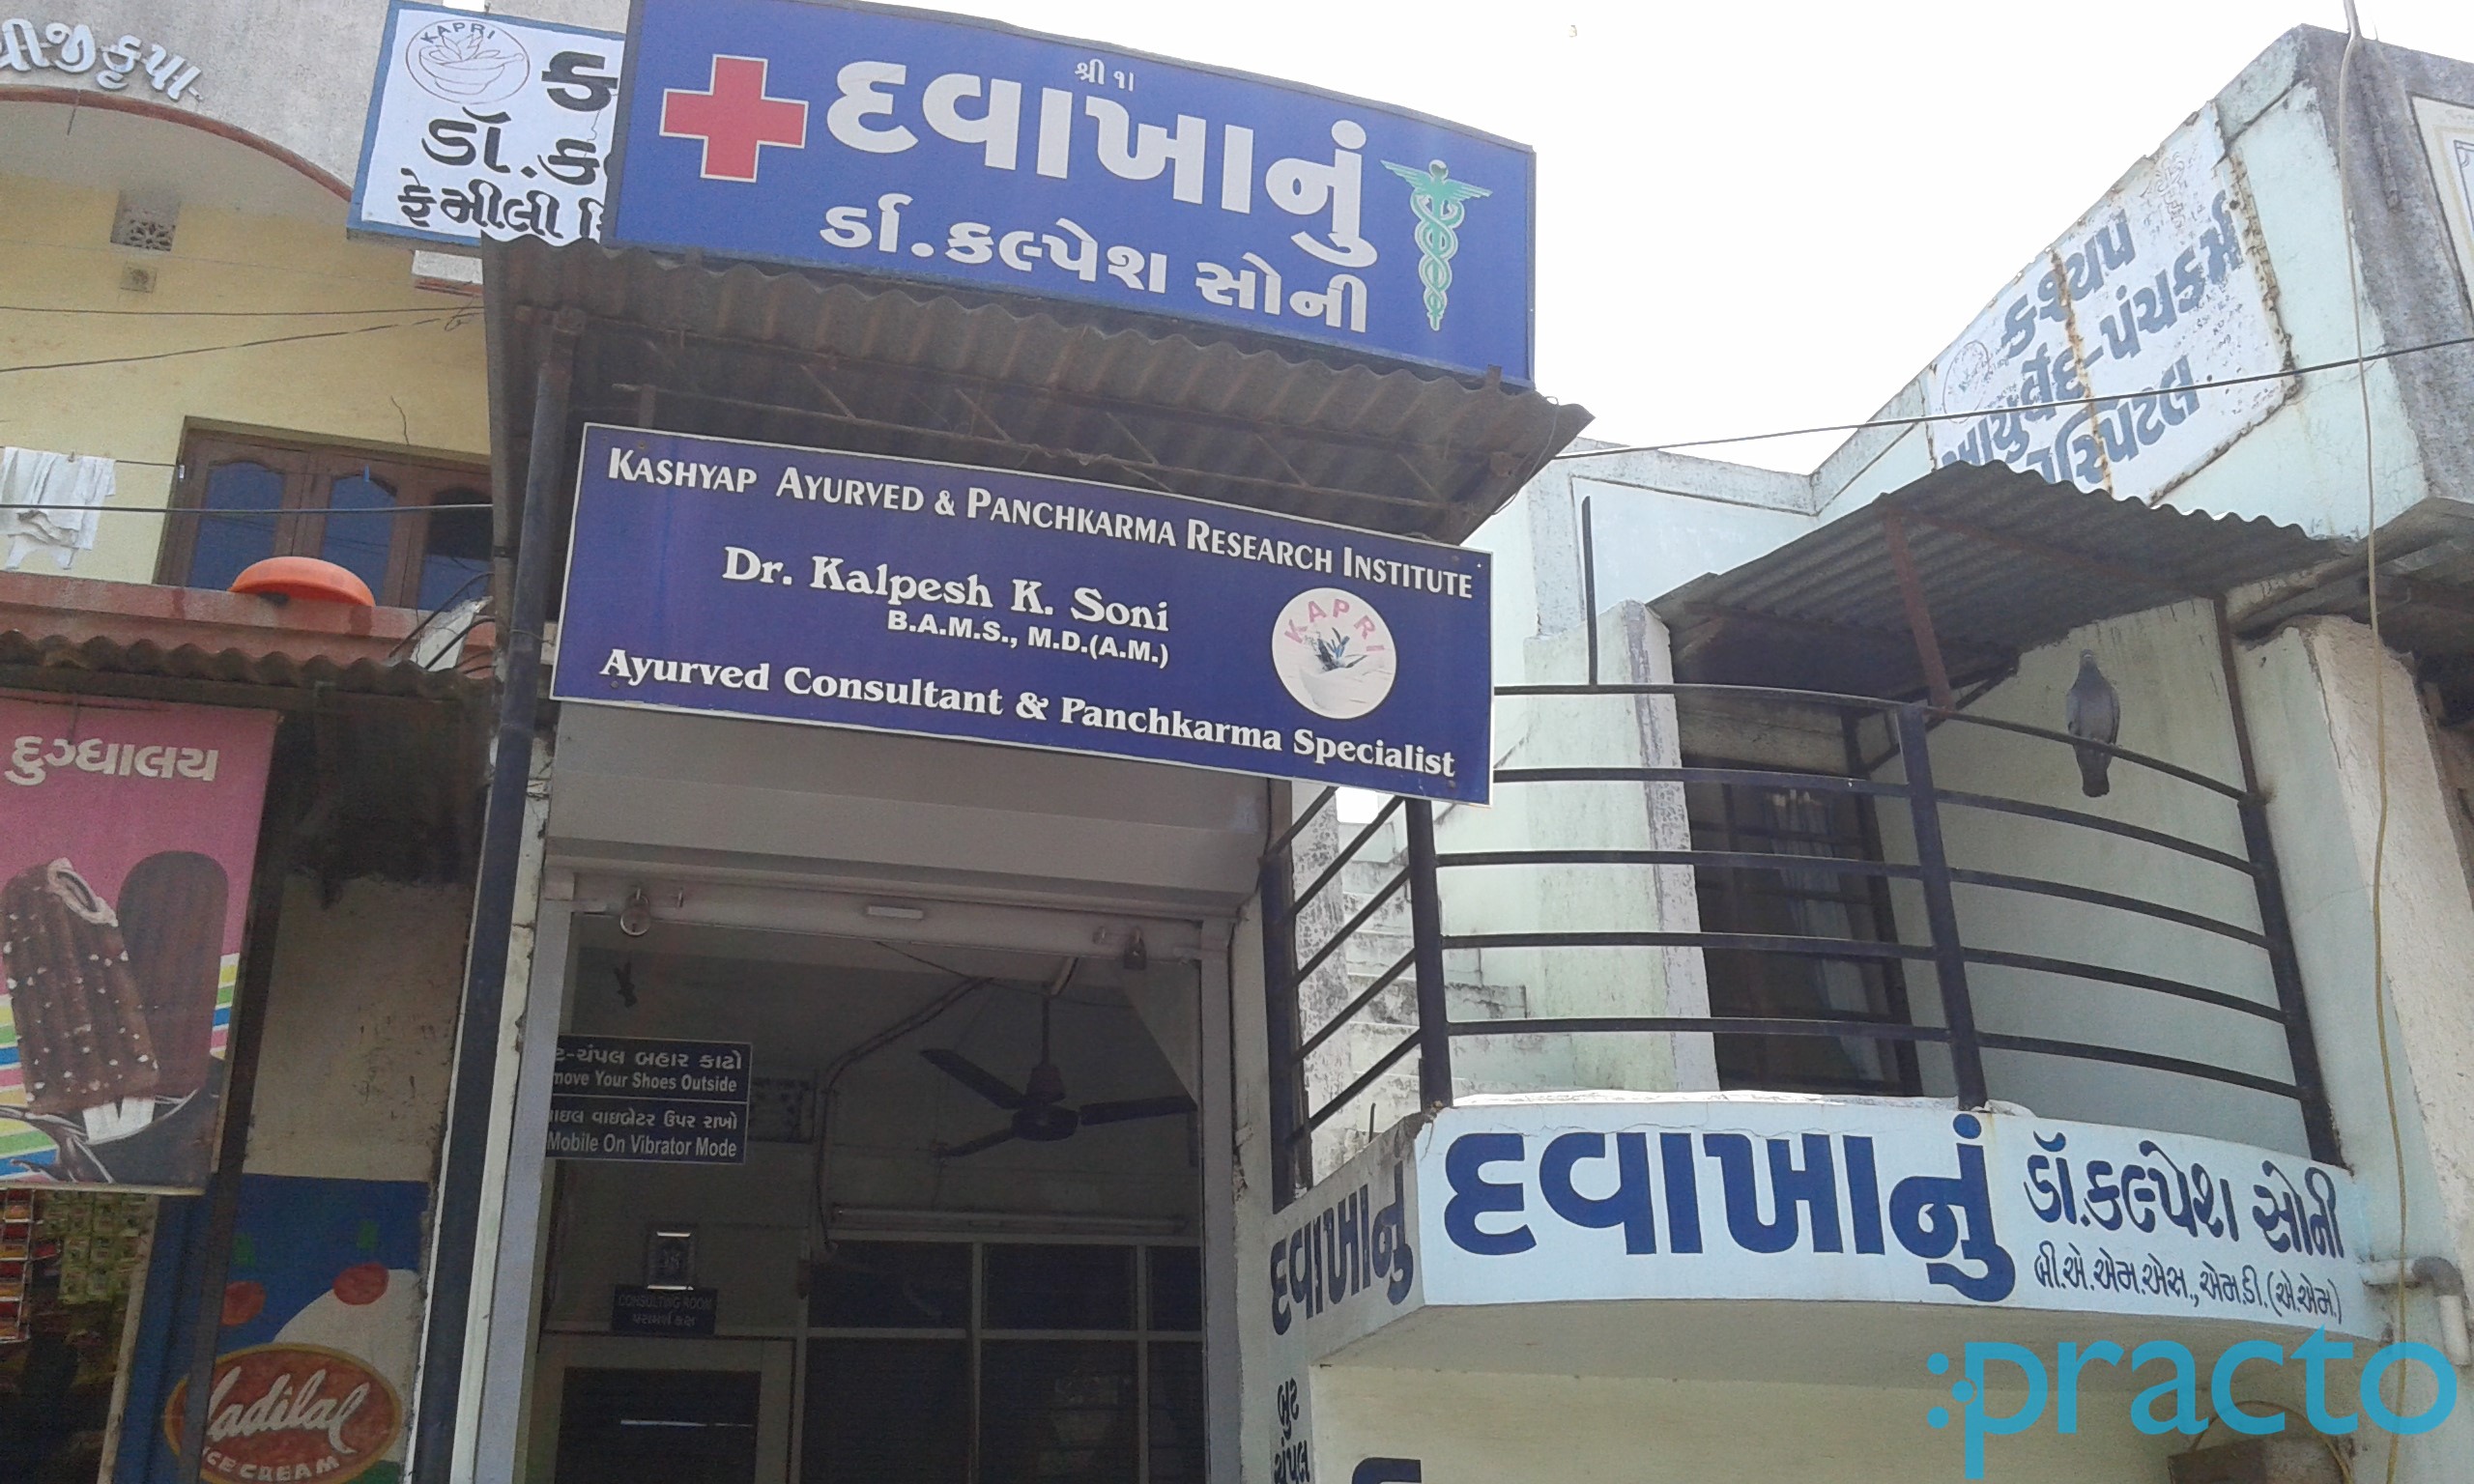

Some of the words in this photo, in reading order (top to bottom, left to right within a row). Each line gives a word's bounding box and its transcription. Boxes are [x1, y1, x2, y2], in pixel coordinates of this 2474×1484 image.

[420, 22, 496, 43] KAPRI
[1074, 58, 1105, 85] શ્રી
[827, 59, 1378, 269] દવાખાનું
[1196, 253, 1368, 333] સોની
[608, 447, 758, 493] KASHYAP
[776, 467, 925, 512] AYURVED
[934, 490, 956, 517] &
[966, 487, 1176, 547] PANCHKARMA
[1186, 519, 1333, 573] RESEARCH
[1343, 547, 1473, 599] INSTITUTE
[722, 547, 792, 585] Dr.
[810, 556, 993, 609] Kalpesh
[1011, 579, 1053, 615] K.
[1071, 586, 1169, 632] Soni
[887, 611, 1019, 648] B.A.M.S.,
[1027, 626, 1169, 670] M.D.(A.M.)
[1283, 597, 1385, 653] KAPRI
[599, 648, 770, 693] Ayurved
[784, 667, 1003, 717] Consultant
[1016, 691, 1049, 721] &
[1060, 696, 1282, 752] Panchkarma
[1293, 728, 1456, 778] Specialist
[595, 1070, 628, 1088] Your
[632, 1071, 676, 1091] Shoes
[681, 1073, 737, 1093] Outside
[547, 1130, 599, 1153] Mobile
[603, 1132, 626, 1154] On
[630, 1134, 692, 1156] Vibrator
[696, 1137, 737, 1157] Mode
[663, 1109, 697, 1128] ઉપર
[703, 1110, 738, 1130] રાખો
[1445, 1113, 2016, 1302] દવાખાનું
[2252, 1160, 2345, 1259] સોની
[240, 1455, 340, 1482] CREAM
